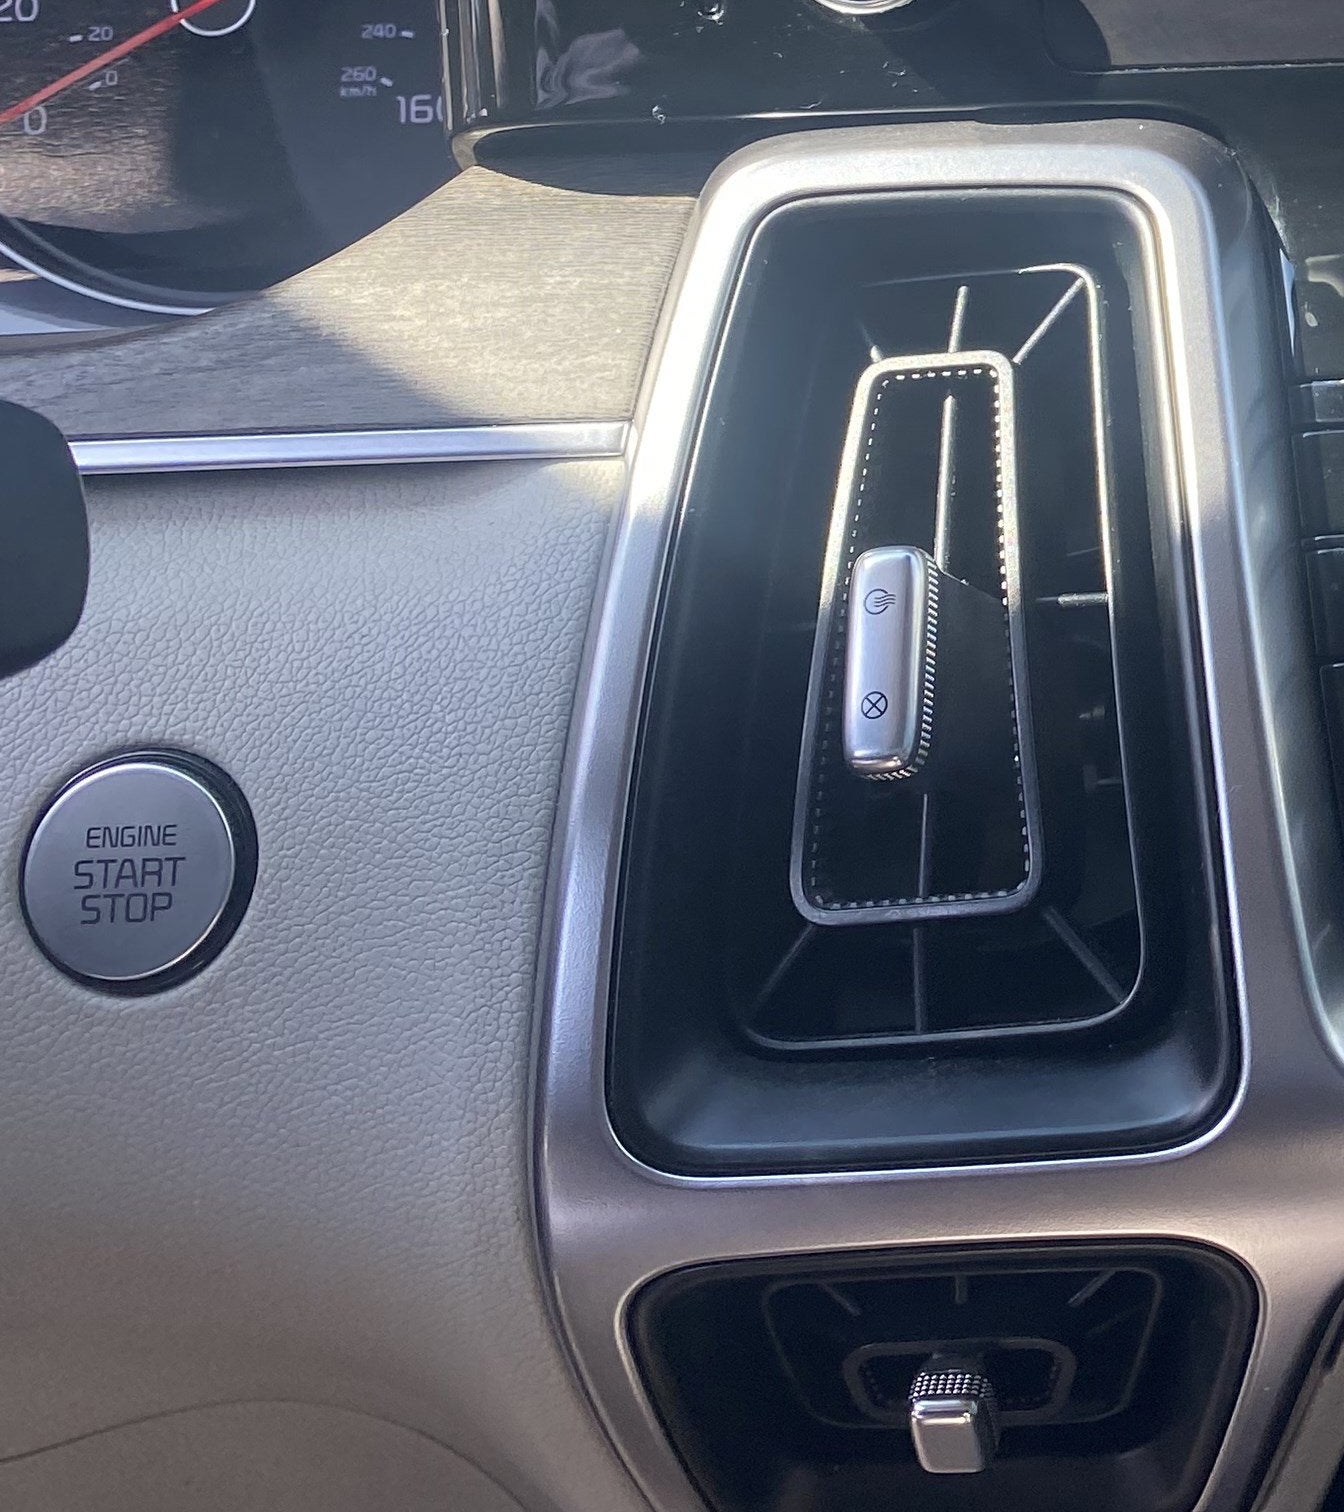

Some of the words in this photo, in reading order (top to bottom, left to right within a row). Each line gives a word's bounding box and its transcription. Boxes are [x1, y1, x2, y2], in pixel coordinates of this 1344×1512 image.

[87, 27, 114, 41] 20
[361, 24, 397, 39] 240
[105, 70, 118, 86] 0
[340, 66, 378, 82] 260
[23, 105, 48, 136] 0
[396, 94, 443, 124] 16
[86, 823, 178, 849] ENGINE
[73, 856, 187, 890] START
[80, 891, 173, 925] STOP
